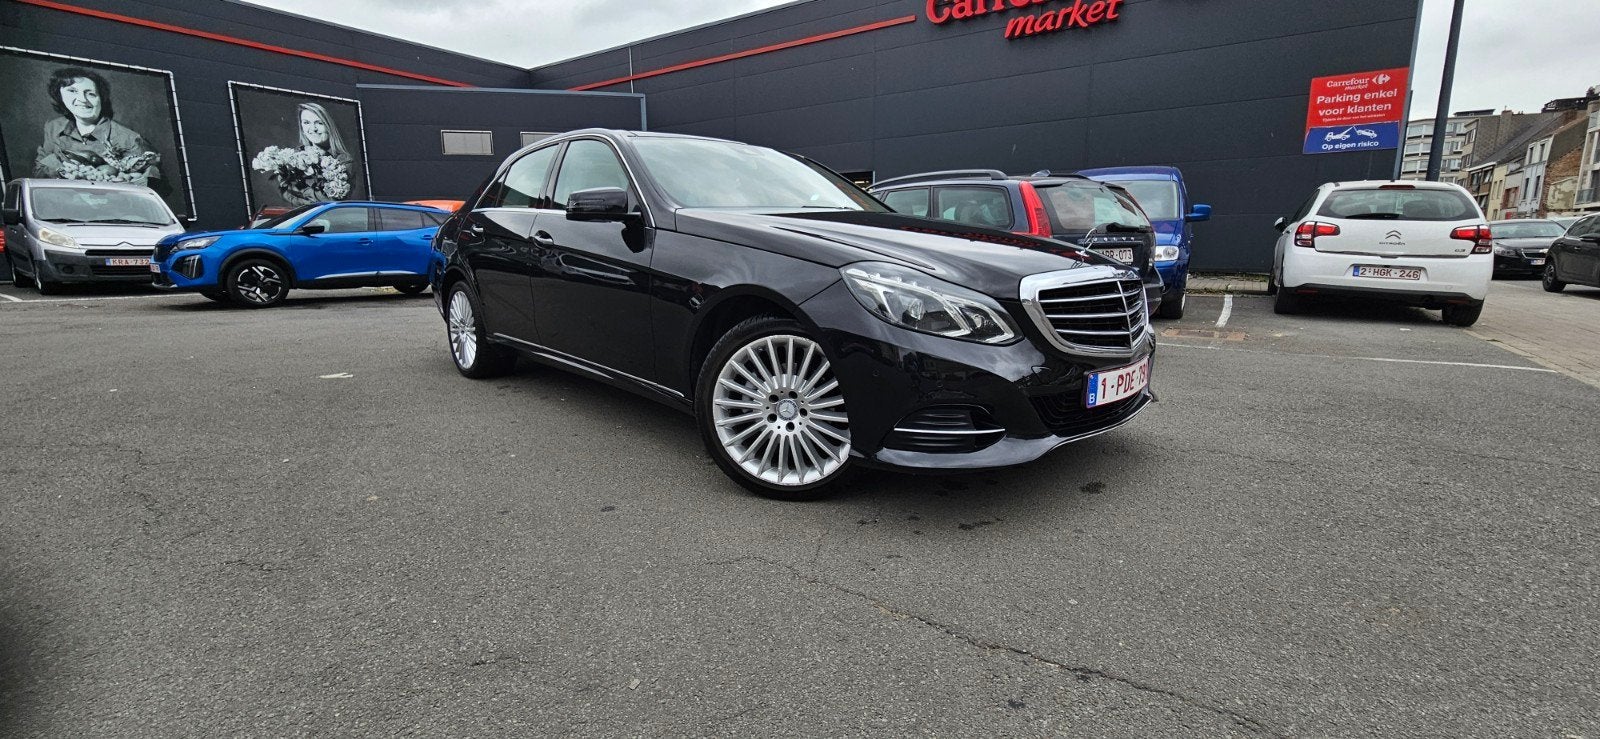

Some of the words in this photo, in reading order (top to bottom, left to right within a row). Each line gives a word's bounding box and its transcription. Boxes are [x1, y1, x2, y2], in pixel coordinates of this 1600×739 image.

[1004, 0, 1119, 38] market
[1326, 78, 1369, 87] Carrefour
[1316, 93, 1360, 104] Parking
[1364, 88, 1397, 100] enkel
[1318, 107, 1344, 116] voor
[1347, 103, 1392, 114] klanten
[1321, 143, 1333, 151] Op
[1335, 142, 1356, 150] eigen
[1357, 140, 1379, 148] risico
[1088, 393, 1096, 404] B
